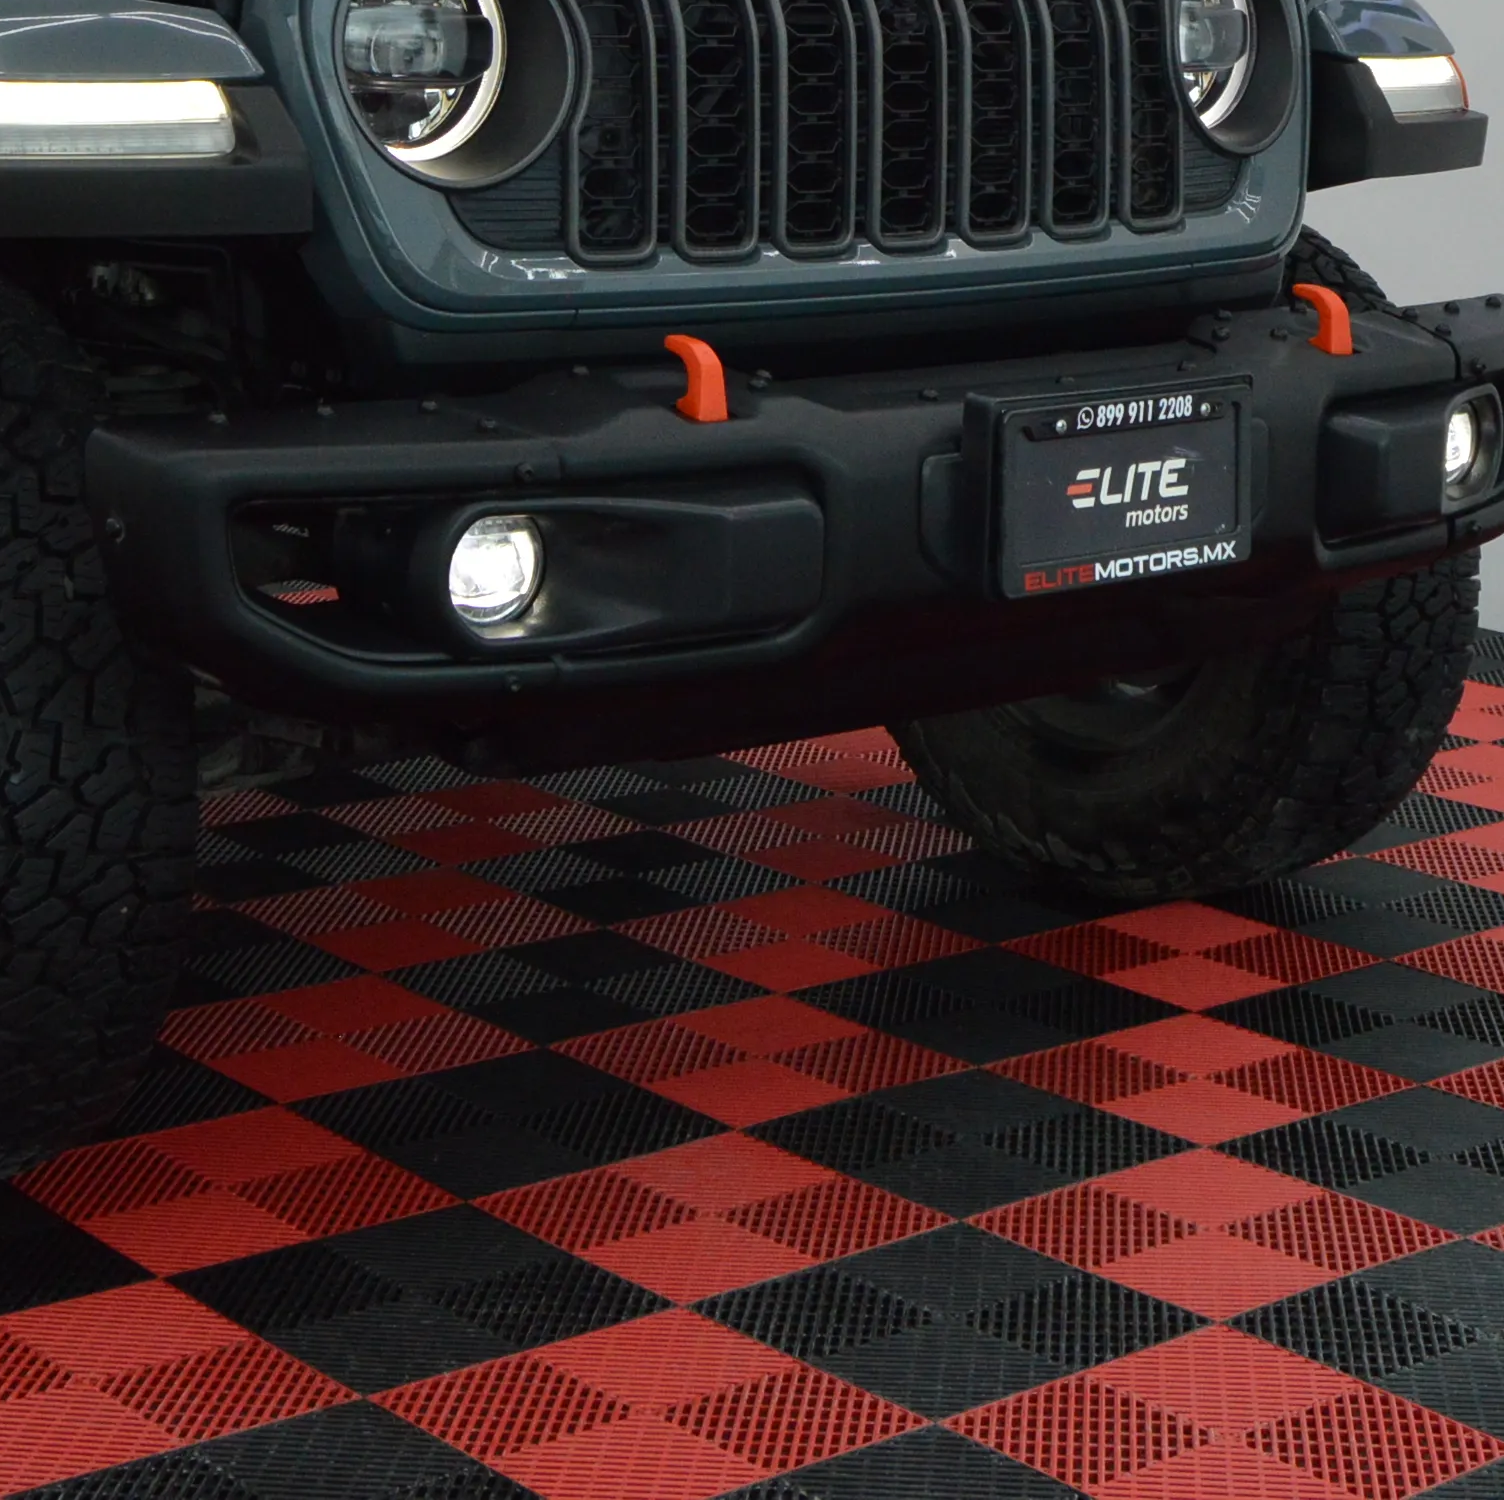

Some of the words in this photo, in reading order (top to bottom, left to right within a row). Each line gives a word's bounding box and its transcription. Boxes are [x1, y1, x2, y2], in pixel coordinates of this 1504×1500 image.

[1096, 402, 1124, 428] 899
[1128, 399, 1154, 424] 911
[1158, 394, 1194, 421] 2208
[1066, 457, 1190, 509] ELITE
[1125, 502, 1190, 528] motors
[1023, 539, 1237, 592] ELITEMOTORS.MX
